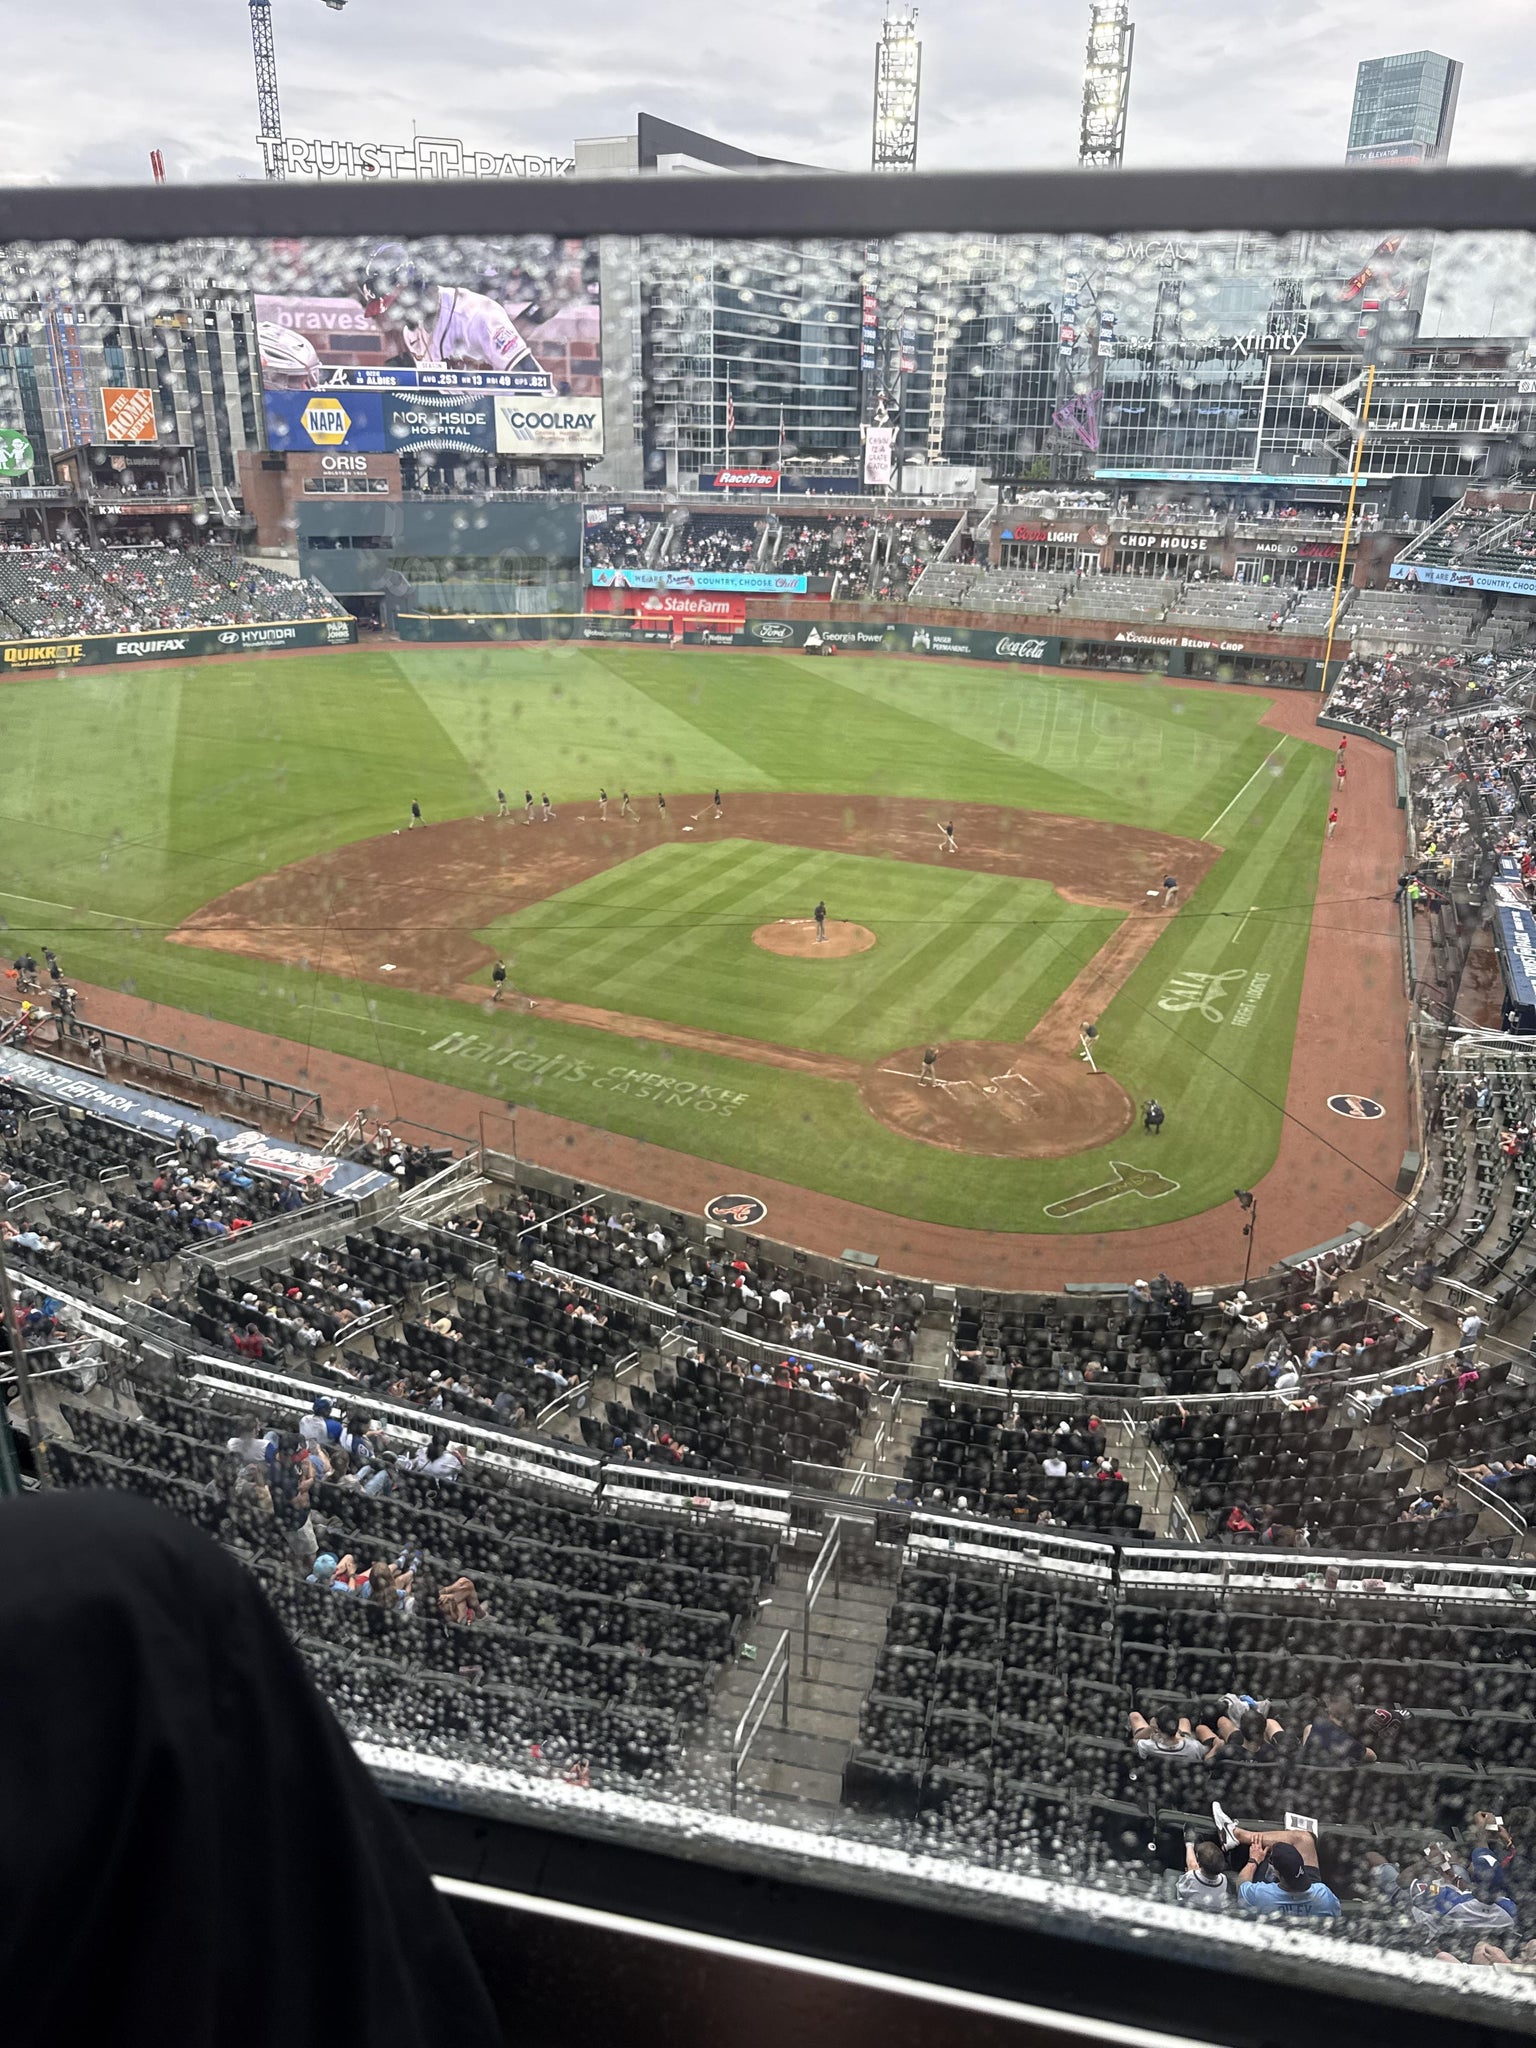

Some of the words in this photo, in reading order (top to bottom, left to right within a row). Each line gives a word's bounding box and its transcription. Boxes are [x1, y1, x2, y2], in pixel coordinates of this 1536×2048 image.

[256, 136, 404, 179] TRUIST
[475, 151, 575, 179] PARK
[1368, 149, 1398, 159] ELEVATOR
[1232, 328, 1306, 356] xfinity
[366, 376, 397, 386] ALBIES
[437, 374, 458, 385] .253
[472, 375, 483, 385] 13
[499, 376, 511, 386] 49
[528, 377, 547, 387] .821
[109, 394, 129, 414] THE
[107, 388, 152, 440] HOME
[309, 411, 344, 432] NAPA
[511, 413, 596, 429] COOLRAY
[127, 409, 155, 439] DEPOT
[412, 426, 470, 435] HOSPITAL
[322, 456, 367, 470] ORIS
[720, 473, 773, 484] RaceTrac
[1014, 526, 1047, 541] Coors
[1047, 531, 1079, 543] LIGHT
[1120, 535, 1156, 547] CHOP
[1160, 537, 1208, 550] HOUSE
[1256, 543, 1282, 552] MADE
[1286, 545, 1298, 553] TO
[697, 577, 737, 587] COUNTRY,
[739, 579, 772, 587] CHOOSE
[775, 578, 799, 588] Chill
[1425, 571, 1434, 579] WE
[1476, 578, 1511, 589] COUNTRY,
[241, 628, 296, 641] HYUNDAI
[326, 622, 349, 631] PAPA
[327, 631, 350, 639] JOHNS
[760, 624, 785, 637] Ford
[822, 631, 855, 644] Georgia
[857, 632, 883, 643] Power
[1126, 630, 1152, 644] Coors
[1152, 637, 1177, 646] LIGHT
[1181, 638, 1210, 649] BELOW
[1220, 641, 1244, 652] CHOP
[4, 644, 83, 662] QUIKRETE
[116, 639, 186, 656] EQUIFAX
[996, 636, 1048, 658] Coca-Cola
[427, 1031, 595, 1083] Harrah's
[10, 1063, 71, 1089] TRUIST
[88, 1090, 140, 1112] PARK
[141, 1109, 175, 1126] HOME
[606, 1067, 750, 1106] CHEROKEE
[591, 1078, 738, 1117] CASINOS
